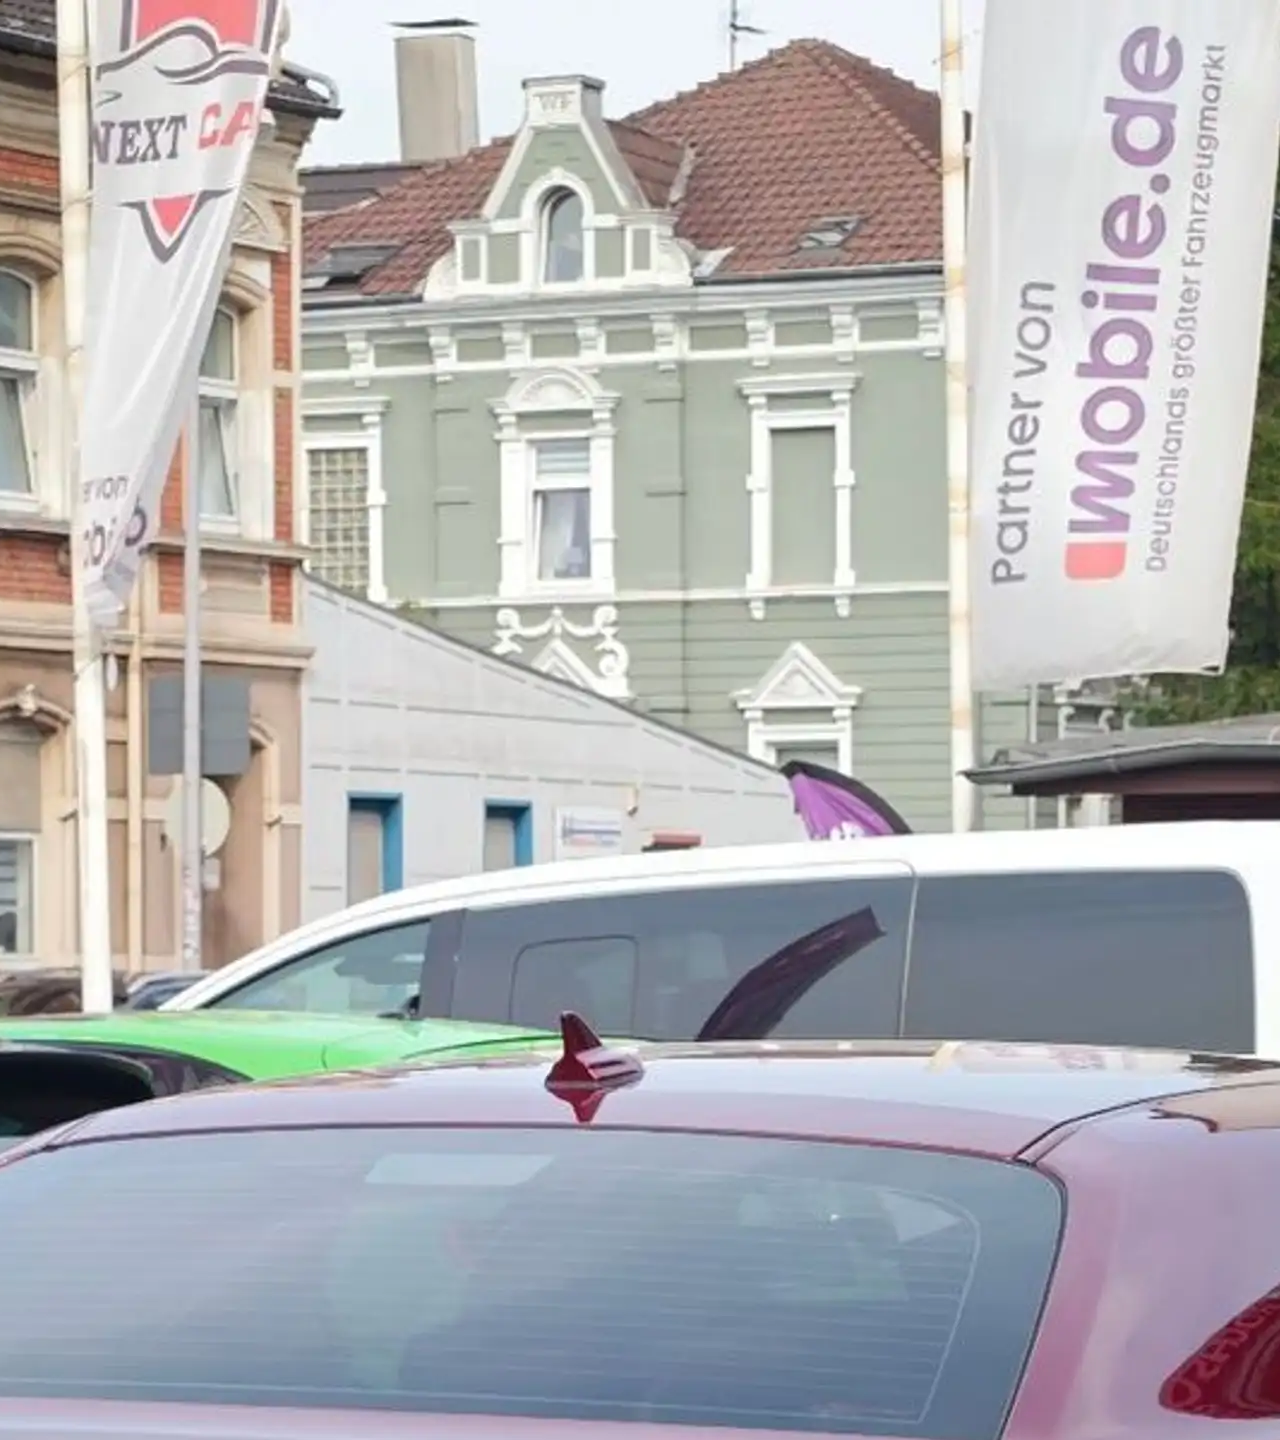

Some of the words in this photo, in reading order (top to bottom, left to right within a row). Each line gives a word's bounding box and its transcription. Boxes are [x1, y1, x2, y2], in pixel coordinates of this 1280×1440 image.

[91, 114, 187, 165] NEXT
[1180, 44, 1227, 268] Fahrzeugmarkt
[1012, 281, 1056, 379] von
[1067, 26, 1184, 533] mobile.de
[1172, 272, 1202, 379] größter
[991, 391, 1044, 585] Partner
[1145, 386, 1189, 572] Deutschlands
